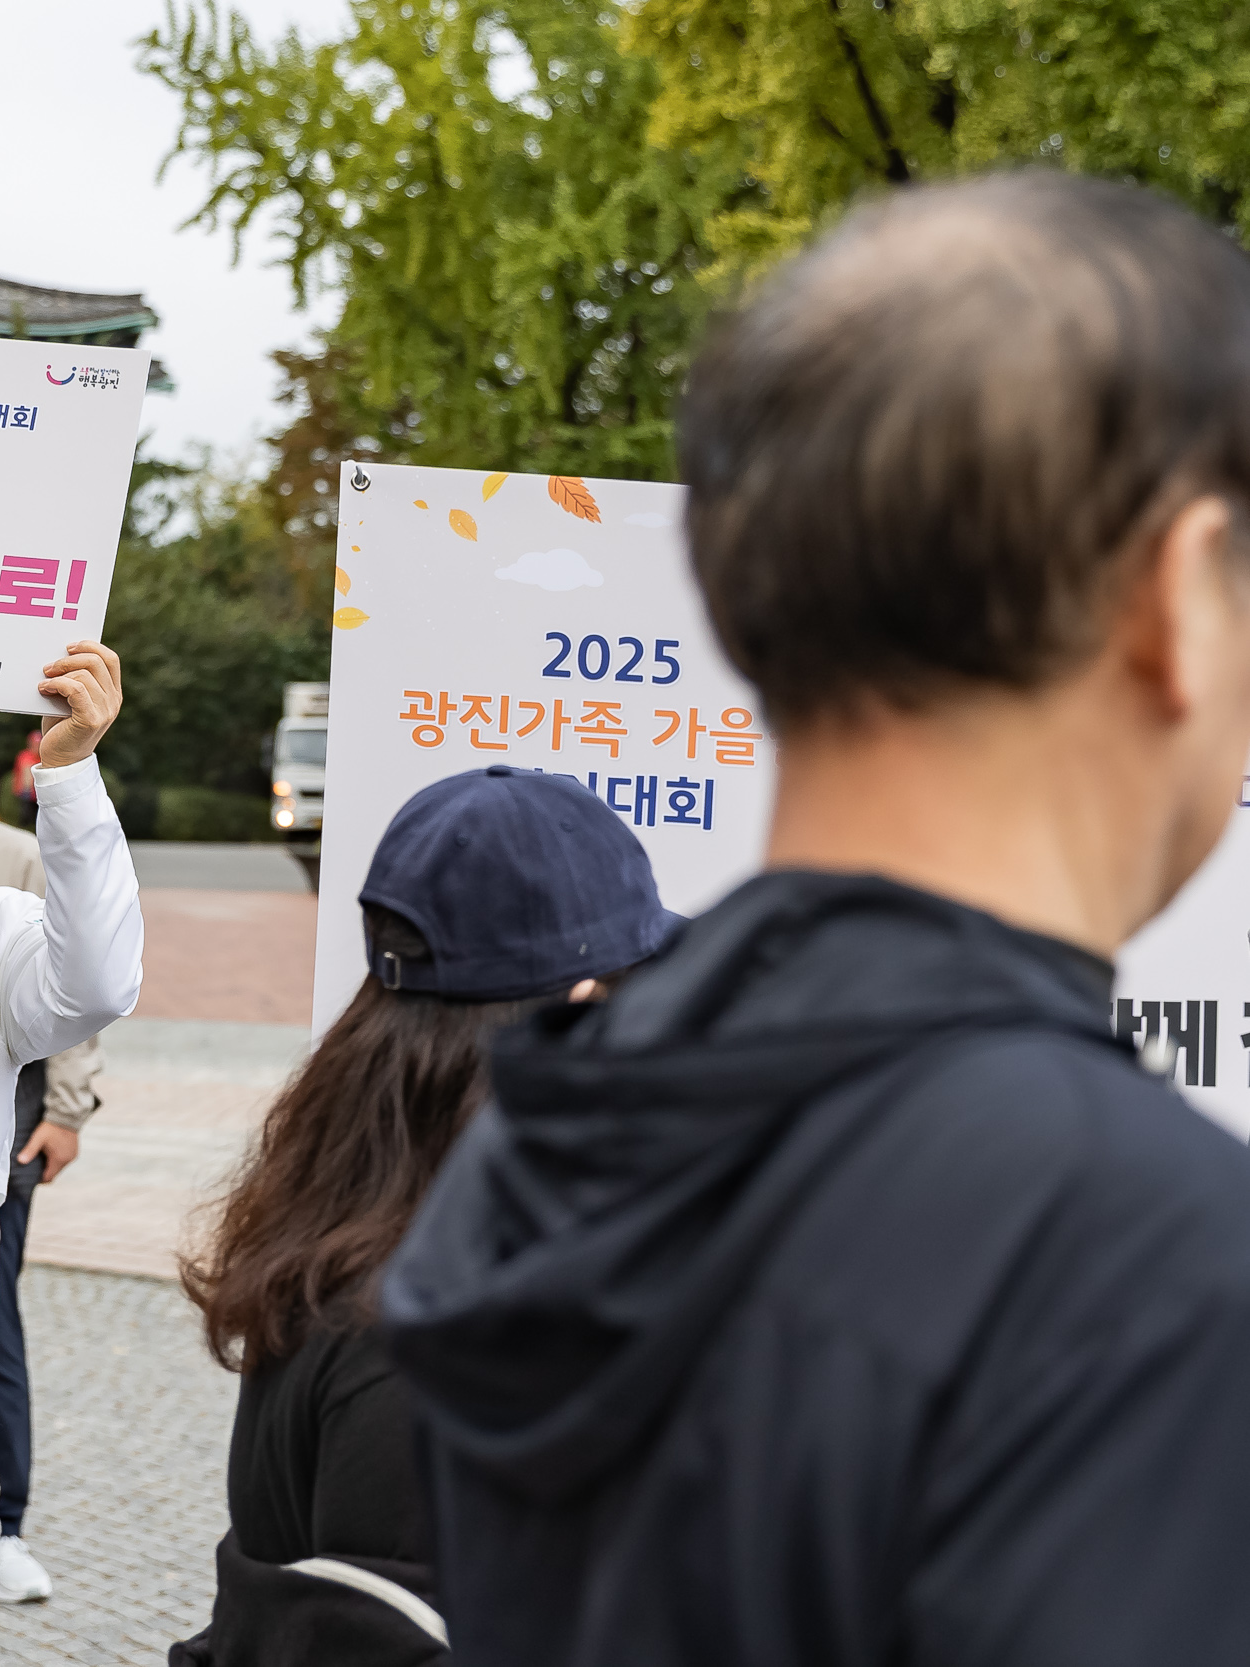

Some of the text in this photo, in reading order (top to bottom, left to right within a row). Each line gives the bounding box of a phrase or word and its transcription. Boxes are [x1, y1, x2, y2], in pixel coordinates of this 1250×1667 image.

[542, 632, 681, 685] 2025
[399, 690, 772, 766] 광진가족 가을
[507, 768, 715, 831] 대회
